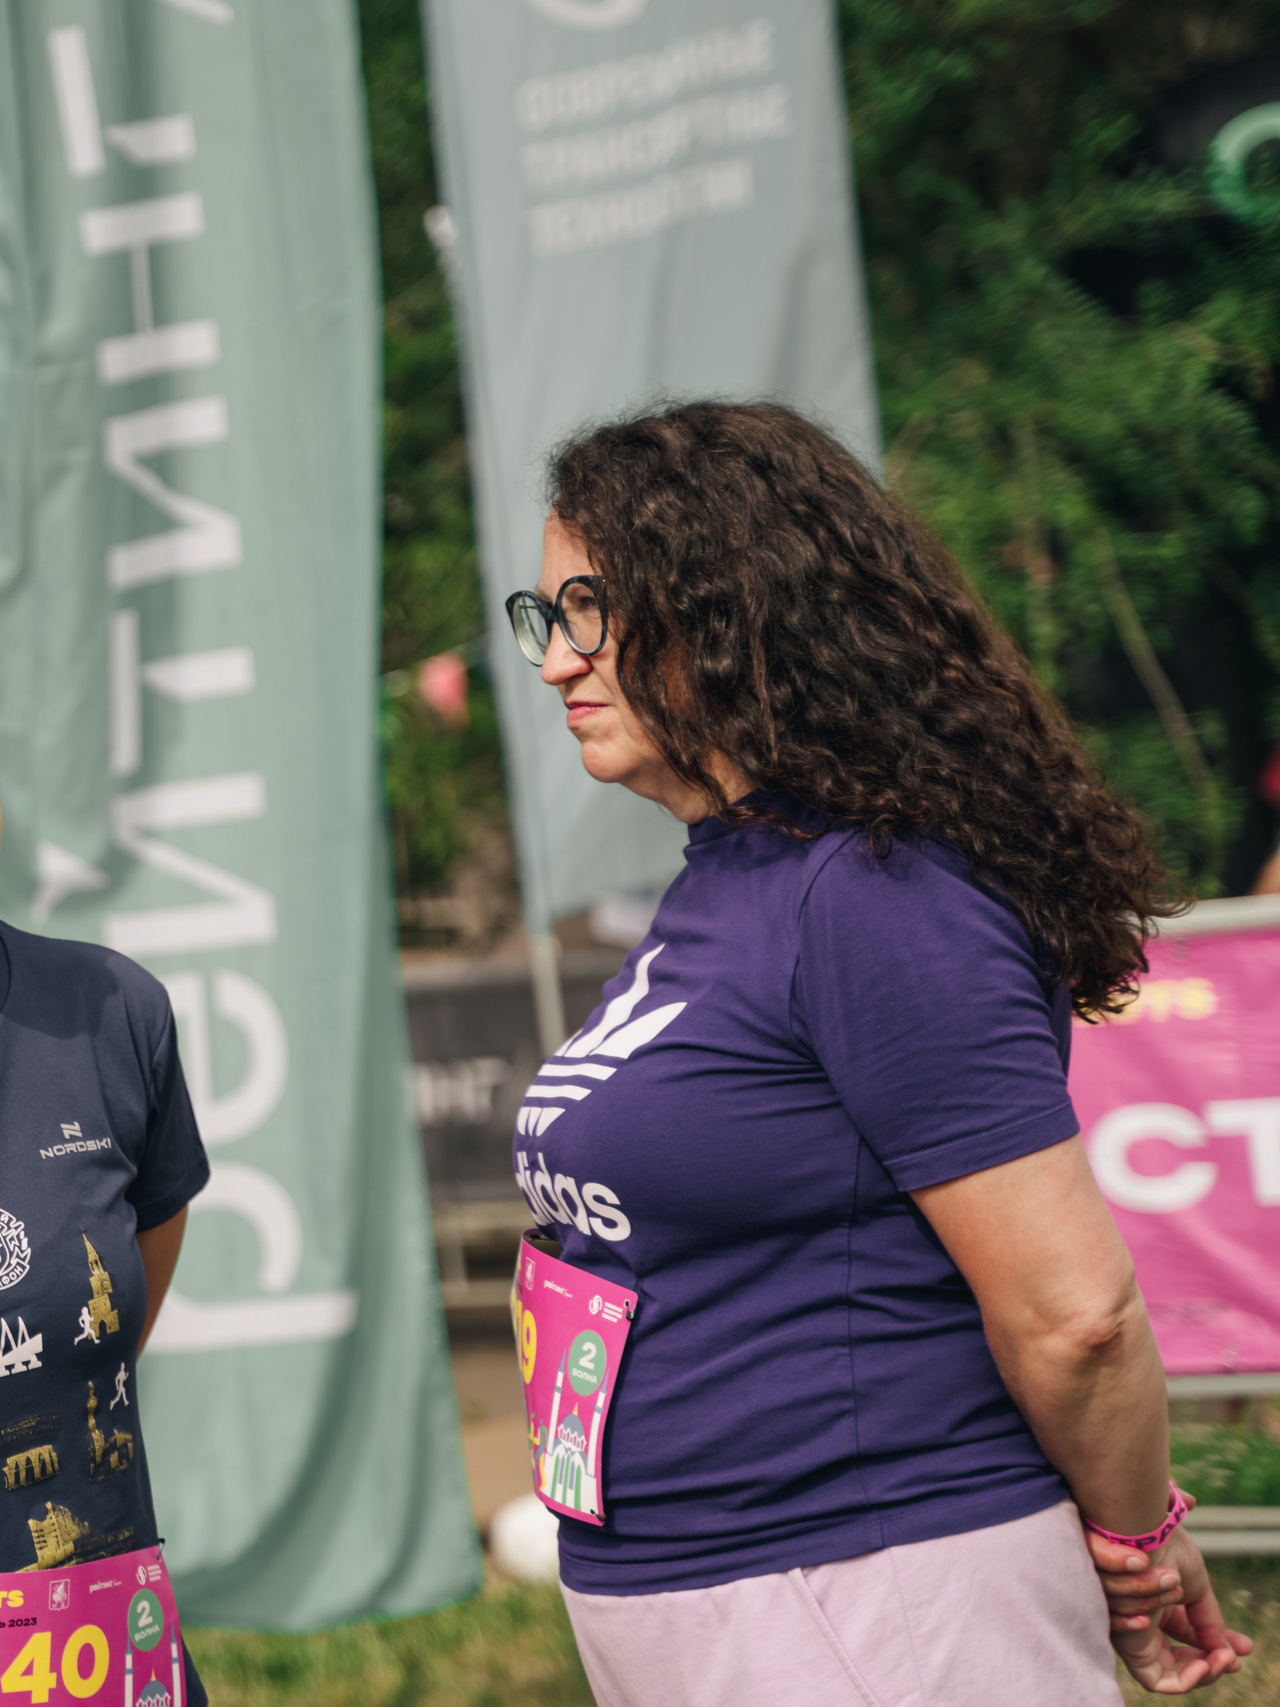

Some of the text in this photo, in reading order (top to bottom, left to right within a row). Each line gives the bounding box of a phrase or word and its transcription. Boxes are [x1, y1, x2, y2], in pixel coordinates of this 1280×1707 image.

[39, 1137, 112, 1160] NORDSKI
[515, 1150, 631, 1242] didas
[578, 1342, 597, 1370] 2
[571, 1368, 598, 1385] ВОЛНА
[7, 1617, 38, 1628] 2023
[136, 1600, 154, 1628] 2
[134, 1624, 160, 1642] ВОЛНА
